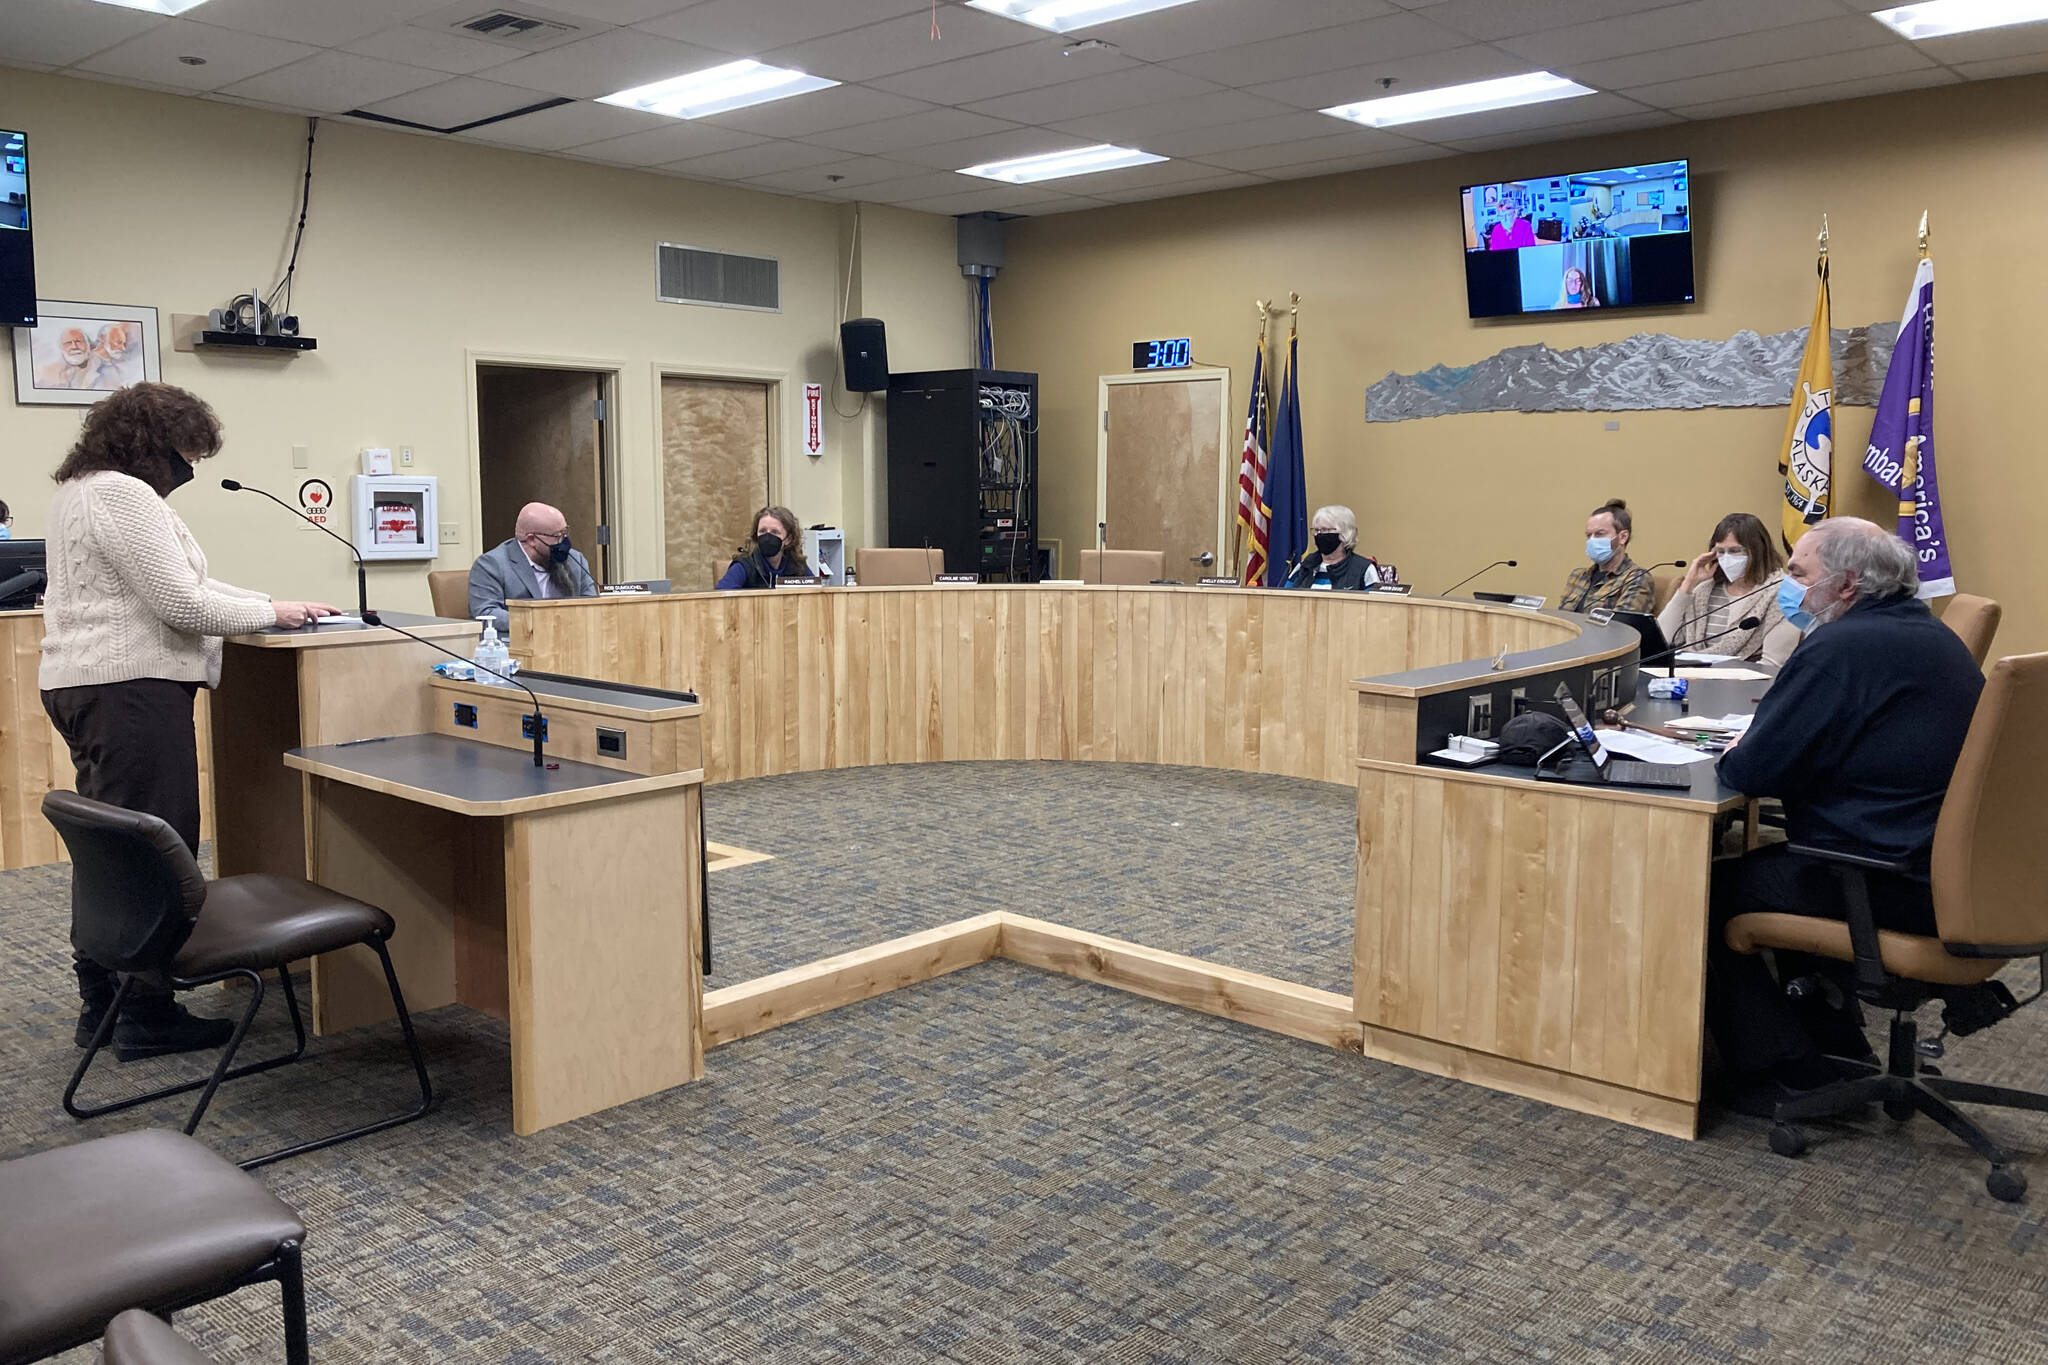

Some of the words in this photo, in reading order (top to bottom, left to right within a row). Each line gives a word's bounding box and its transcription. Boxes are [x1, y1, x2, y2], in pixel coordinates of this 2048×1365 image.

[1147, 338, 1189, 369] 3:00
[1804, 391, 1831, 418] CIT
[1864, 443, 1904, 487] mbat
